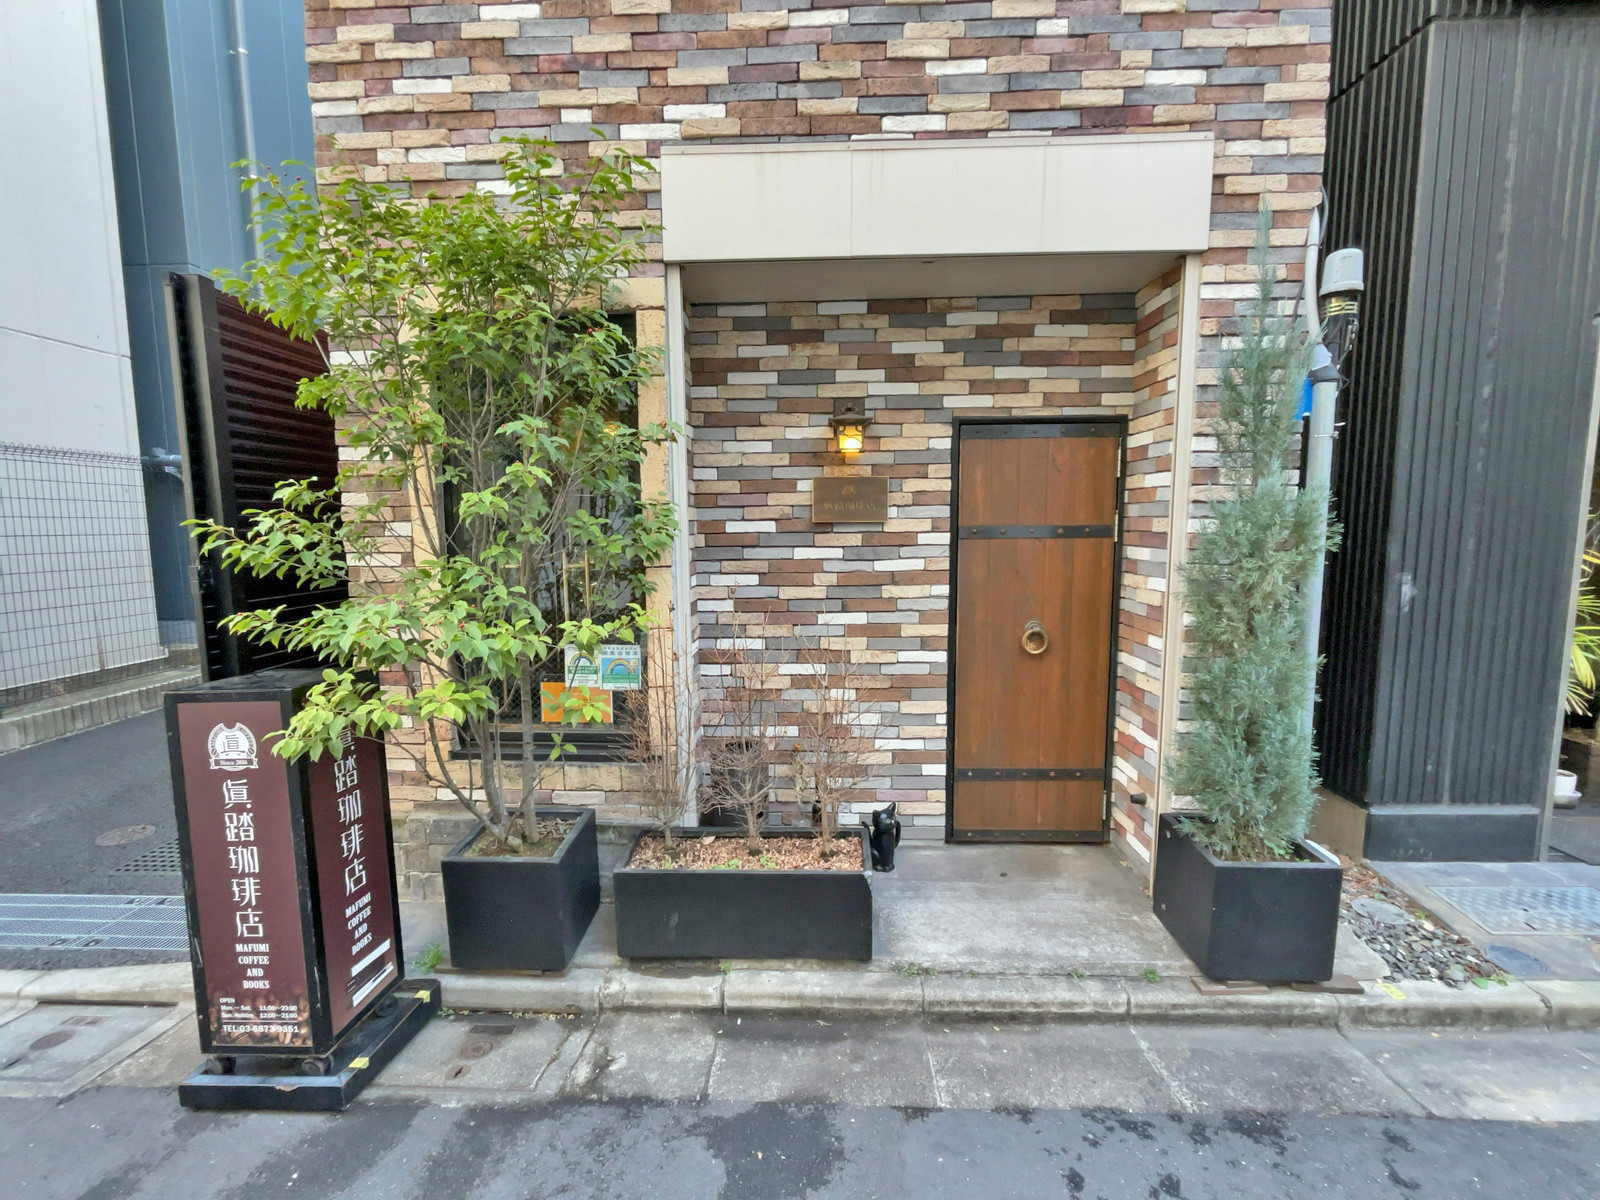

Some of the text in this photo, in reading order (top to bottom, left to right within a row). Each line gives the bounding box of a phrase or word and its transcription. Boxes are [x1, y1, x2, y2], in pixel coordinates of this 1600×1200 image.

[222, 779, 264, 938] 眞踏珈琲店
[345, 892, 372, 919] MAFUMI
[347, 905, 372, 930] COFFEE
[354, 922, 368, 940] AND
[235, 943, 270, 953] MAFUMI
[351, 932, 373, 956] BOOKS
[238, 955, 270, 965] COFFEE
[246, 968, 264, 977] AND
[242, 980, 270, 989] BOOKS
